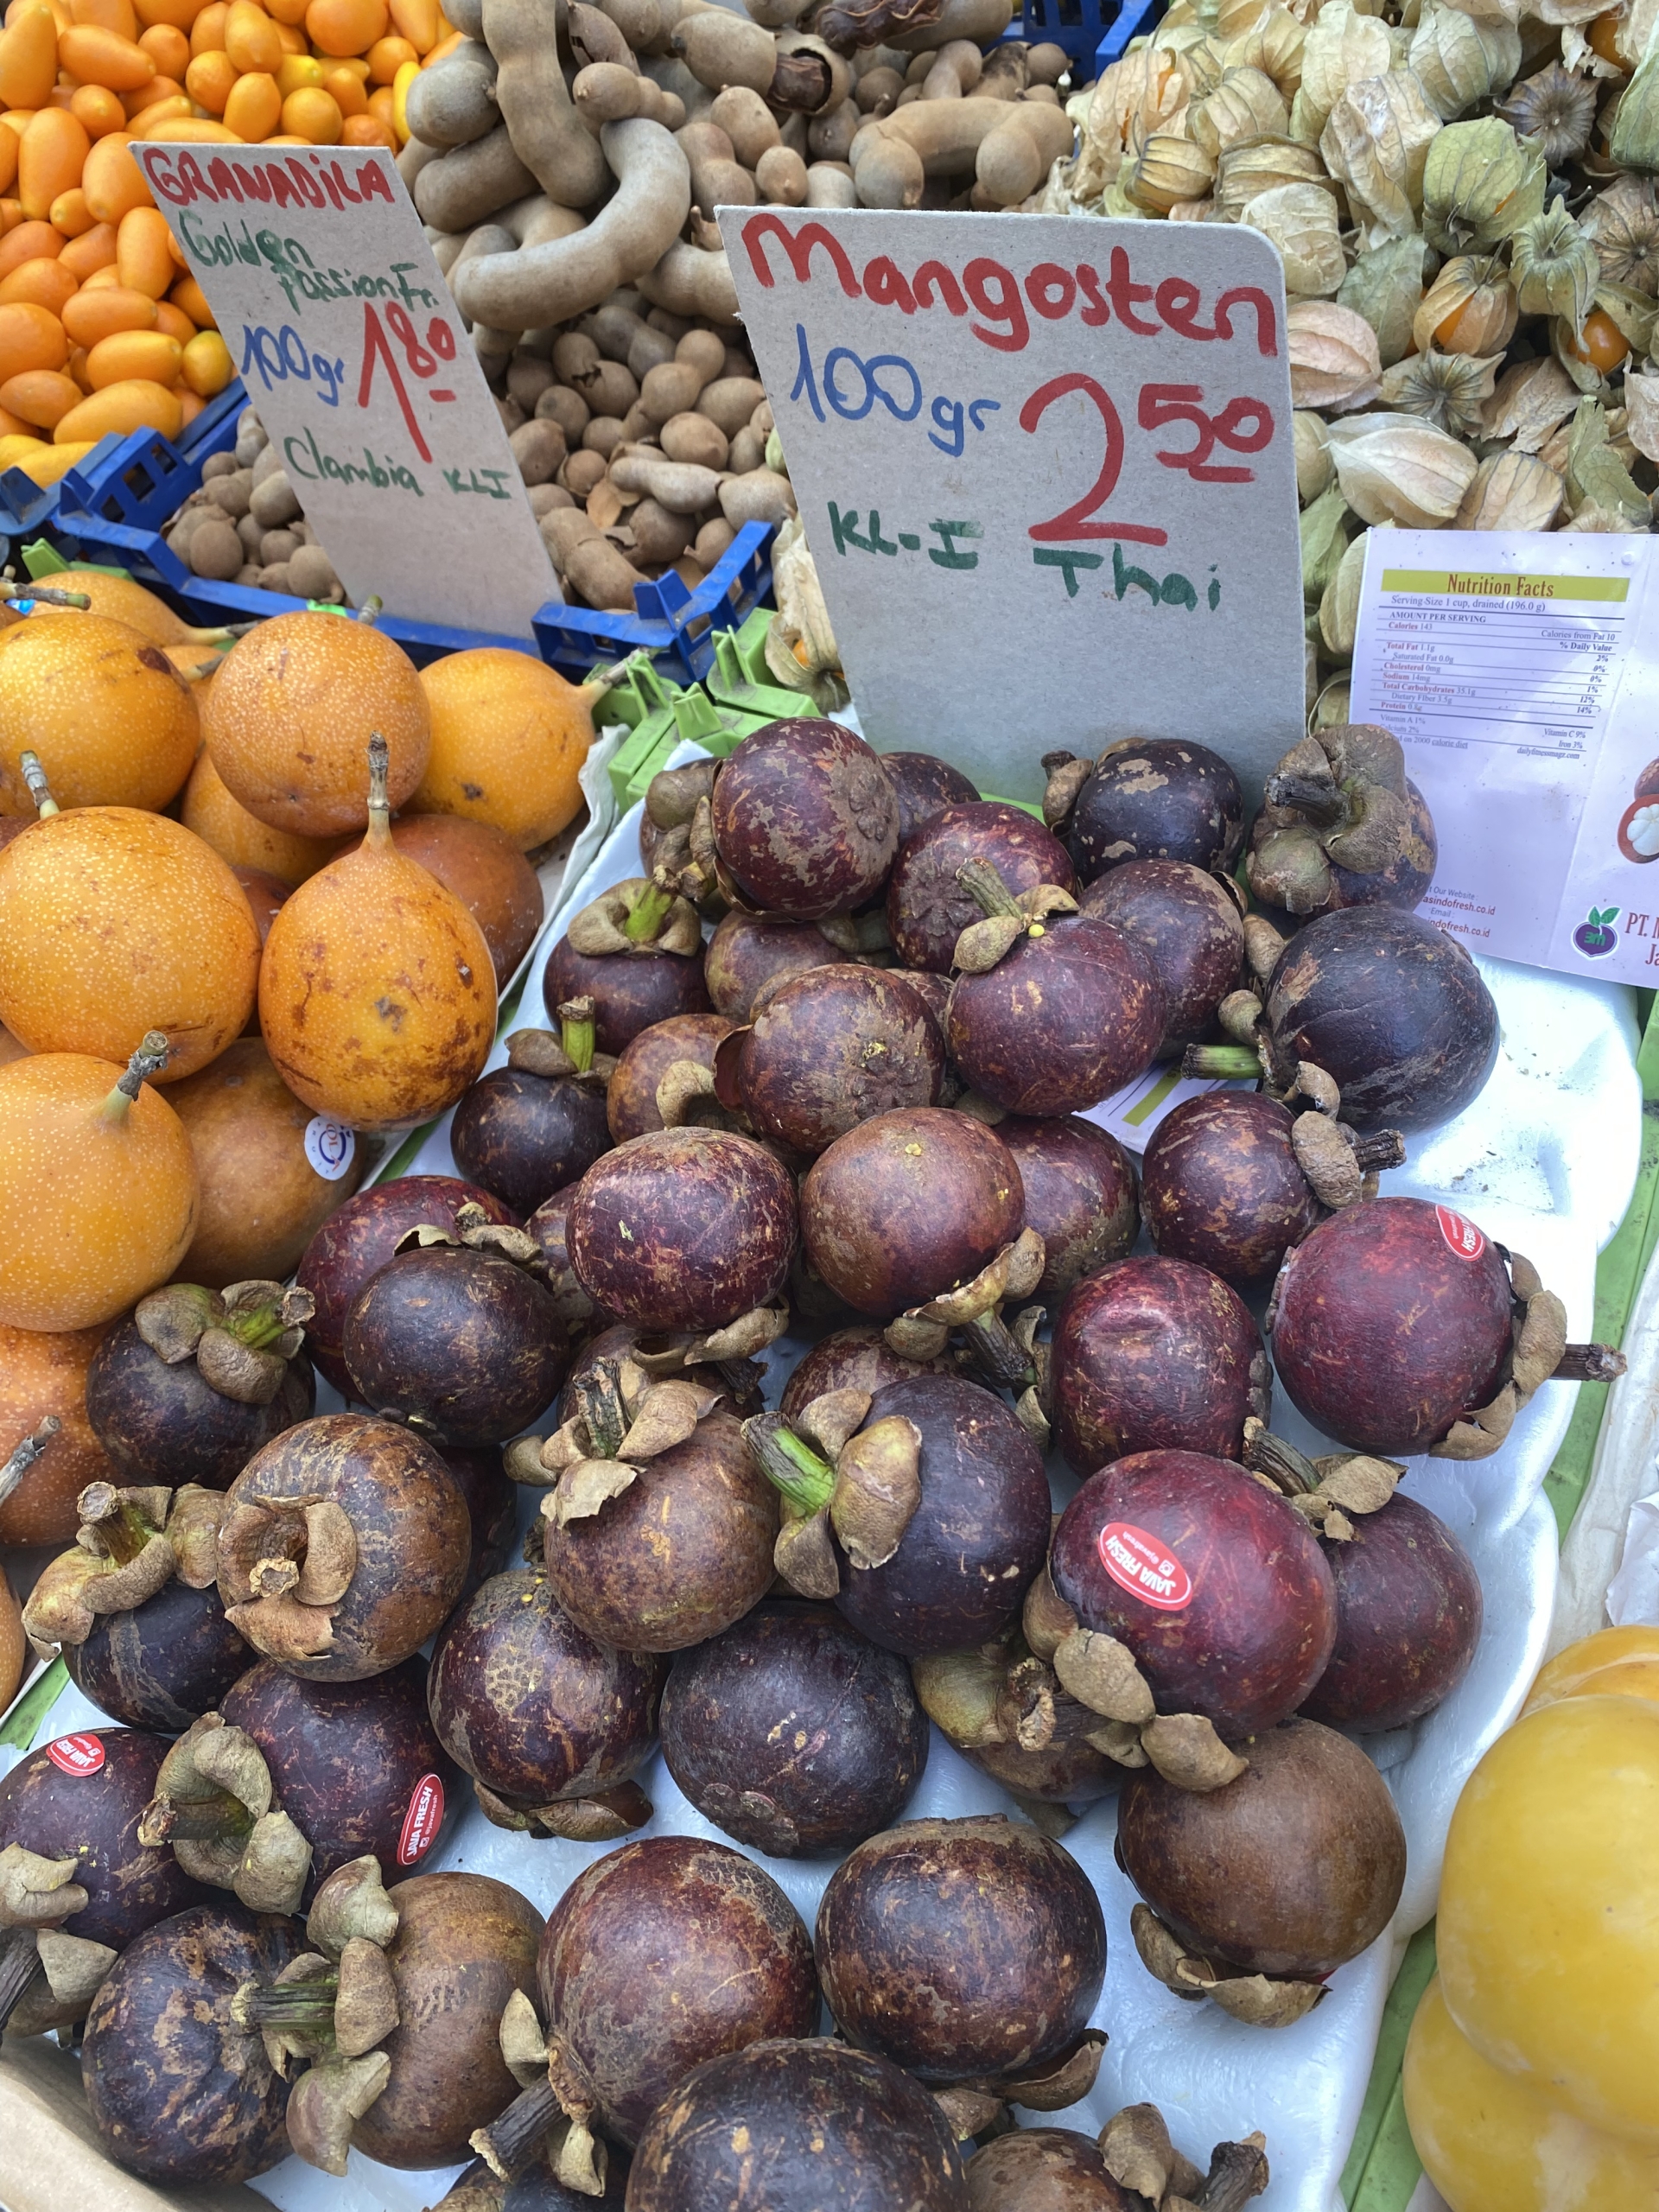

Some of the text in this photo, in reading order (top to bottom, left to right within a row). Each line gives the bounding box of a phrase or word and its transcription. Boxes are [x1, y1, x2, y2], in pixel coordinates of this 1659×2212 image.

[741, 213, 1276, 357] Mangosten
[1033, 542, 1220, 611] Thai
[1447, 574, 1554, 597] Nutrition Facts
[1391, 594, 1423, 607] Serving
[1425, 597, 1443, 607] Size
[1452, 599, 1471, 609] cup,
[1472, 599, 1504, 609] drained
[1506, 601, 1534, 611] (196.0
[1535, 602, 1546, 613] g)
[1389, 612, 1427, 620] AMOUNT
[1447, 614, 1486, 623] SERVING
[1389, 621, 1418, 630] Calories
[1541, 630, 1572, 639] Calories
[1573, 632, 1591, 640] from
[1592, 632, 1605, 641] Fat
[1387, 641, 1435, 652] Total Fat 1.1g
[1570, 642, 1591, 652] Daily
[1592, 644, 1612, 652] Value
[1393, 652, 1425, 661] Saturated
[1439, 655, 1454, 664] 0.0g
[1384, 662, 1424, 671] Cholesterol
[1426, 664, 1441, 673] 0mg
[1382, 672, 1602, 683] Sodium 14mg 0%
[1402, 683, 1455, 694] Carbohydrates
[1456, 687, 1476, 696] 35.1g
[1587, 685, 1599, 694] 1%
[1391, 692, 1415, 702] Dietary
[1580, 696, 1595, 704] 12%
[1381, 701, 1406, 709] Protein
[1577, 706, 1592, 715] 14%
[1380, 714, 1406, 722] Vitamin
[1380, 723, 1407, 734] alcium
[1544, 728, 1567, 737] Vitamin
[1558, 740, 1571, 748] Iron
[1433, 886, 1446, 895] Our
[1422, 895, 1496, 916] asindofresh.co.id
[1624, 912, 1649, 938] PT.
[1461, 1223, 1476, 1252] FRESH
[1122, 1531, 1160, 1565] @javafresh
[1105, 1535, 1176, 1597] JAVA FRESH
[69, 1750, 95, 1768] JAVA
[425, 1795, 438, 1834] @javafresh
[406, 1786, 433, 1857] JAVA FRESH
